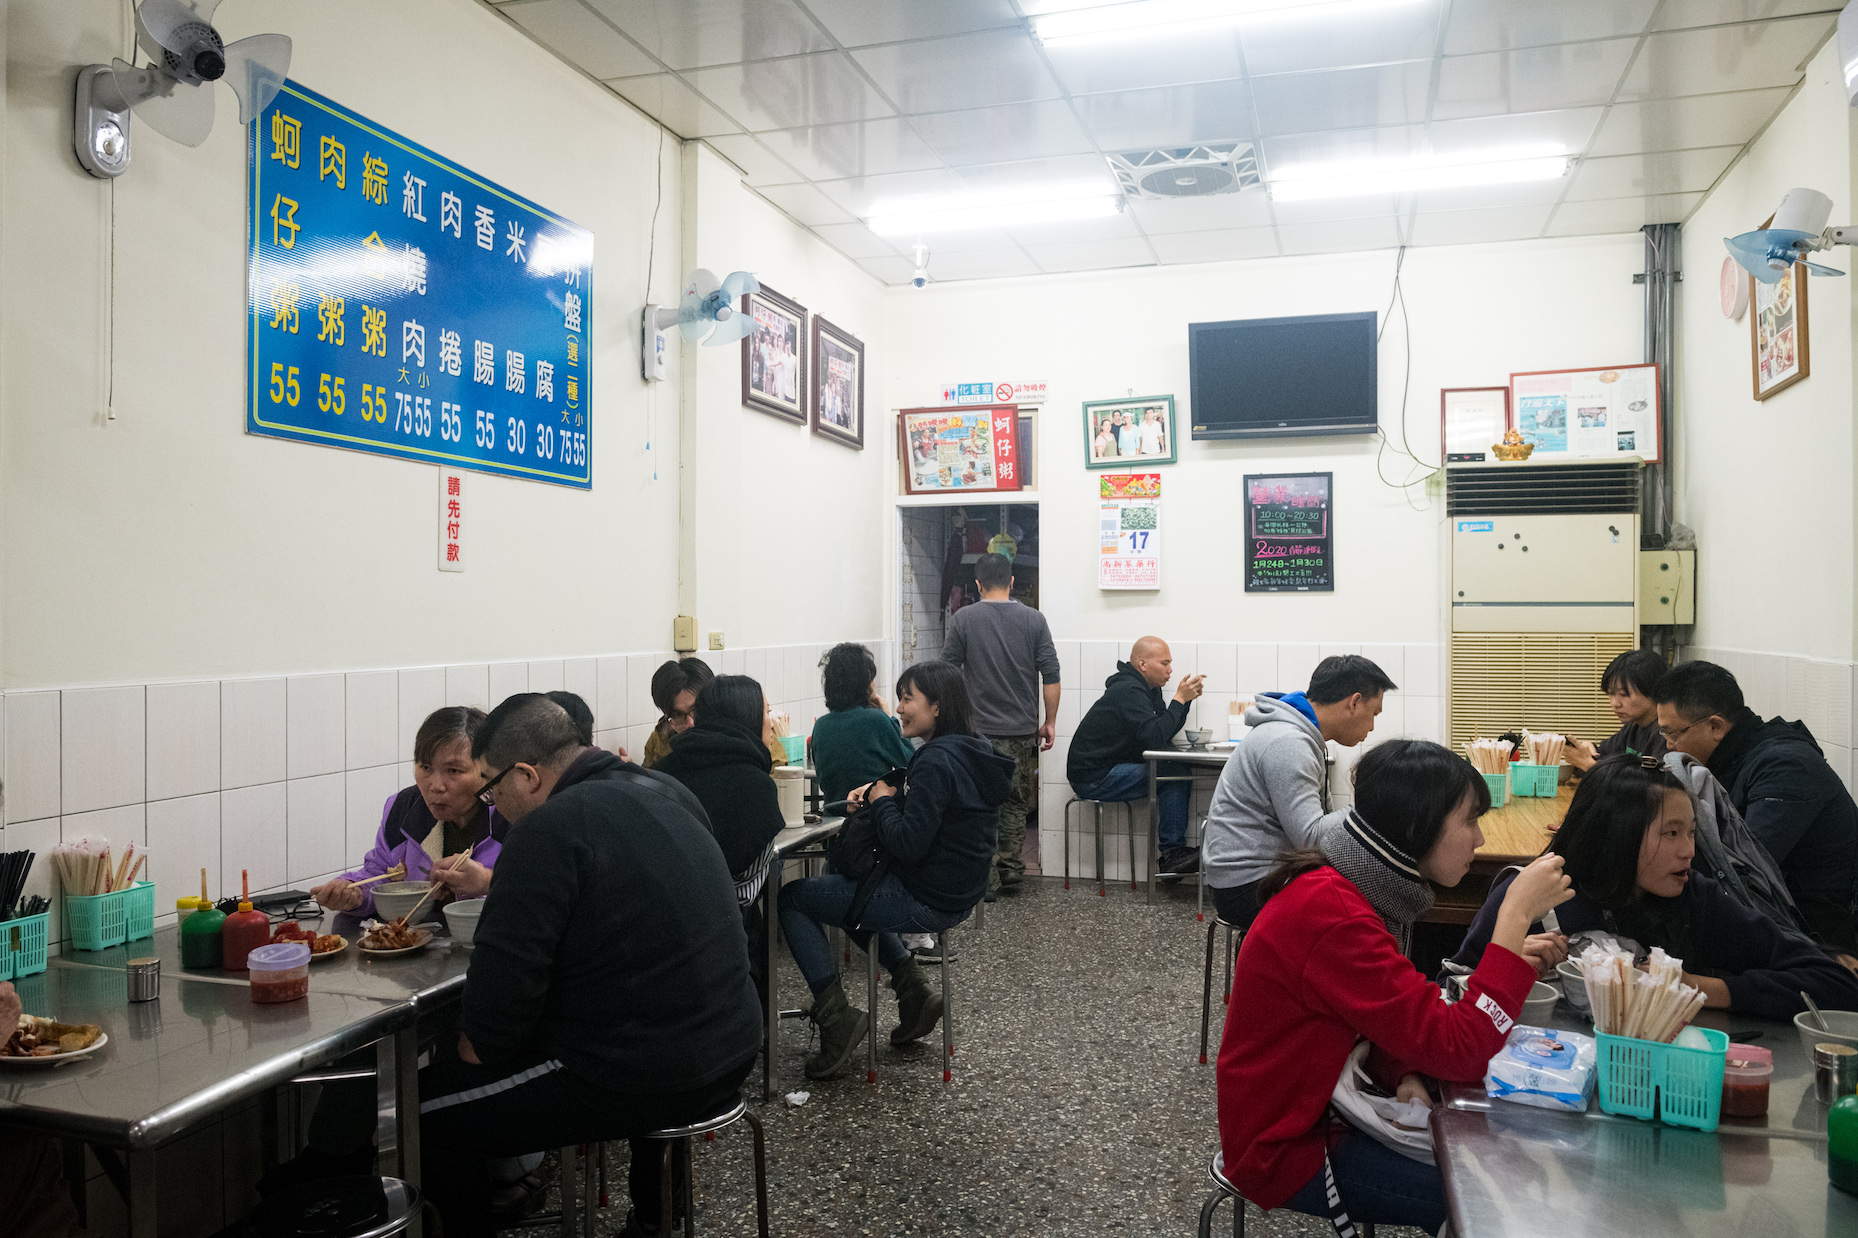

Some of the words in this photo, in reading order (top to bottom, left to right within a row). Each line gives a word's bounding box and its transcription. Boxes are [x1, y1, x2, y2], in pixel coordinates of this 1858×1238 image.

[473, 203, 497, 388] 香腸
[505, 220, 526, 396] 米腸
[269, 362, 301, 407] 55
[317, 372, 346, 416] 55
[397, 366, 411, 386] 大
[417, 369, 430, 389] 小
[361, 383, 388, 424] 55
[394, 391, 412, 436] 75
[414, 396, 432, 439] 55
[440, 402, 462, 443] 55
[475, 409, 495, 450] 55
[507, 416, 526, 456] 30
[536, 423, 554, 460] 30
[559, 429, 572, 465] 75
[573, 432, 585, 468] 55
[993, 416, 1014, 480] 蚵仔粥
[447, 476, 461, 562] 請先付款
[1129, 531, 1150, 549] 17
[1483, 998, 1509, 1028] ROCK
